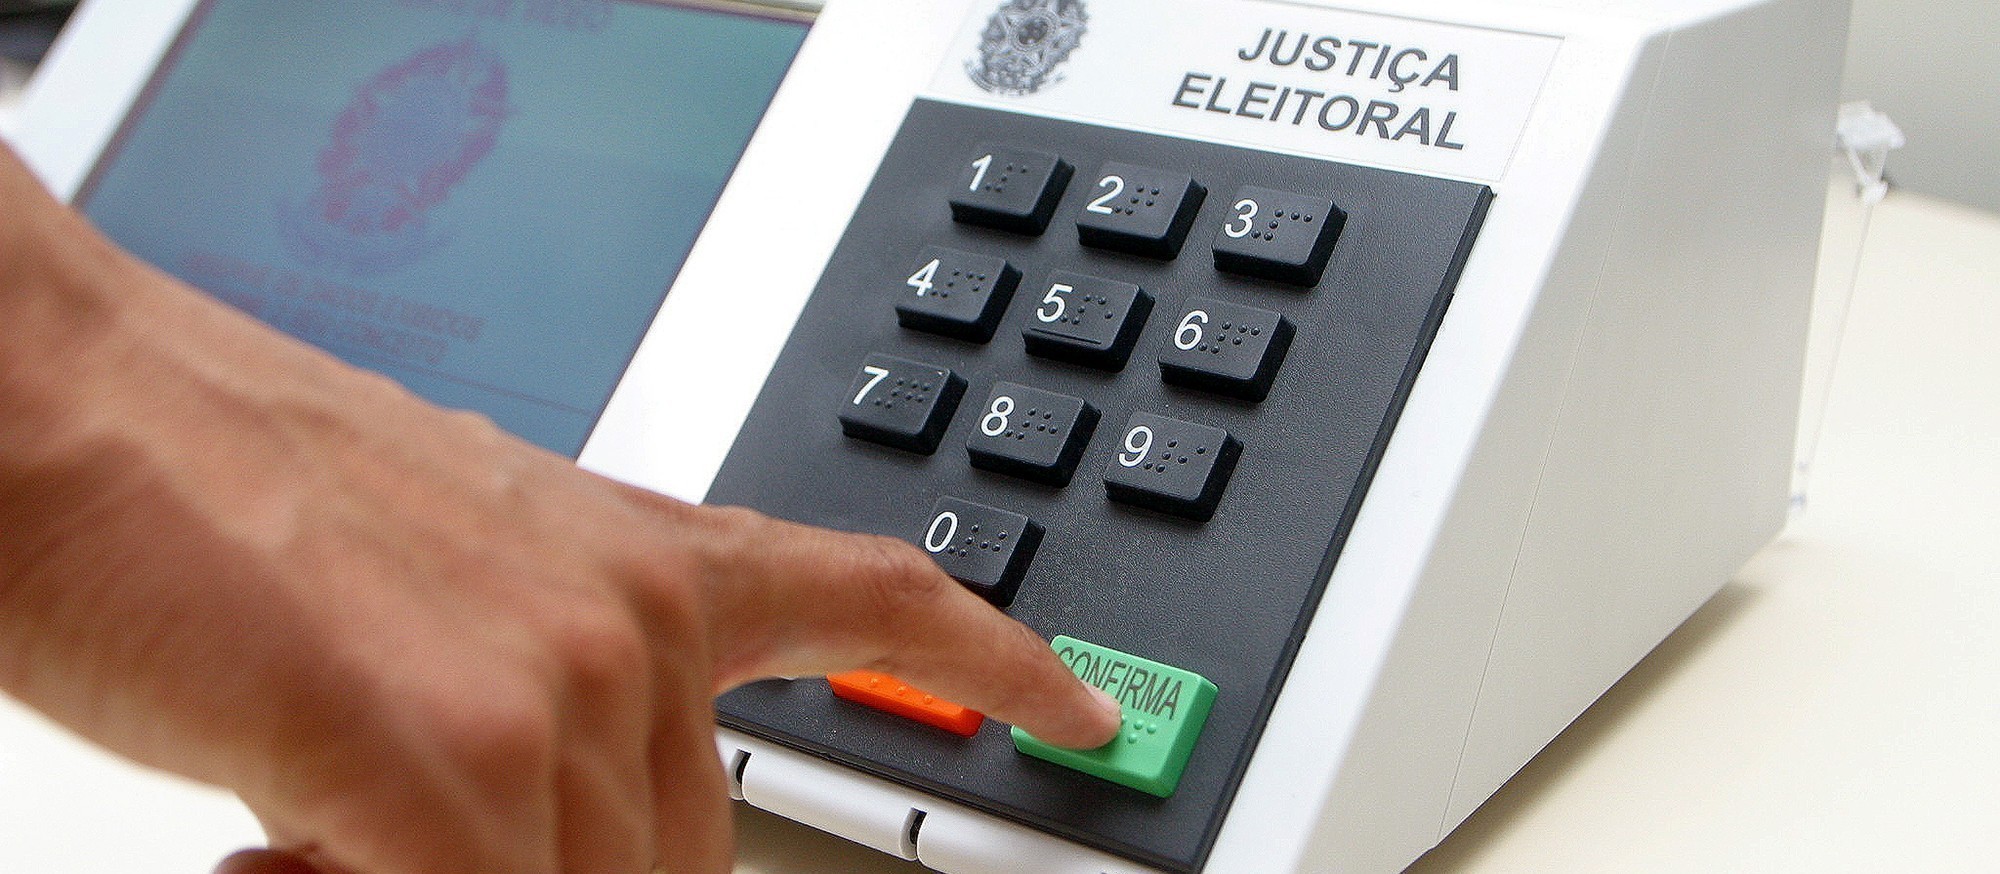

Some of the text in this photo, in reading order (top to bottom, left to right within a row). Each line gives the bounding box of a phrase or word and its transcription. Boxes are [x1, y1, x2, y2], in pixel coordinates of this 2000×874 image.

[1238, 27, 1461, 93] JUSTIÇA
[1171, 72, 1465, 151] ELEITORAL
[969, 154, 993, 192] 1
[1086, 175, 1126, 215] 2
[1224, 199, 1259, 239] 3
[906, 258, 941, 297] 4
[1036, 283, 1074, 323] 5
[1173, 309, 1209, 351] 6
[852, 365, 889, 405] 7
[980, 396, 1016, 437] 8
[1118, 426, 1154, 468] 9
[924, 511, 959, 553] 0
